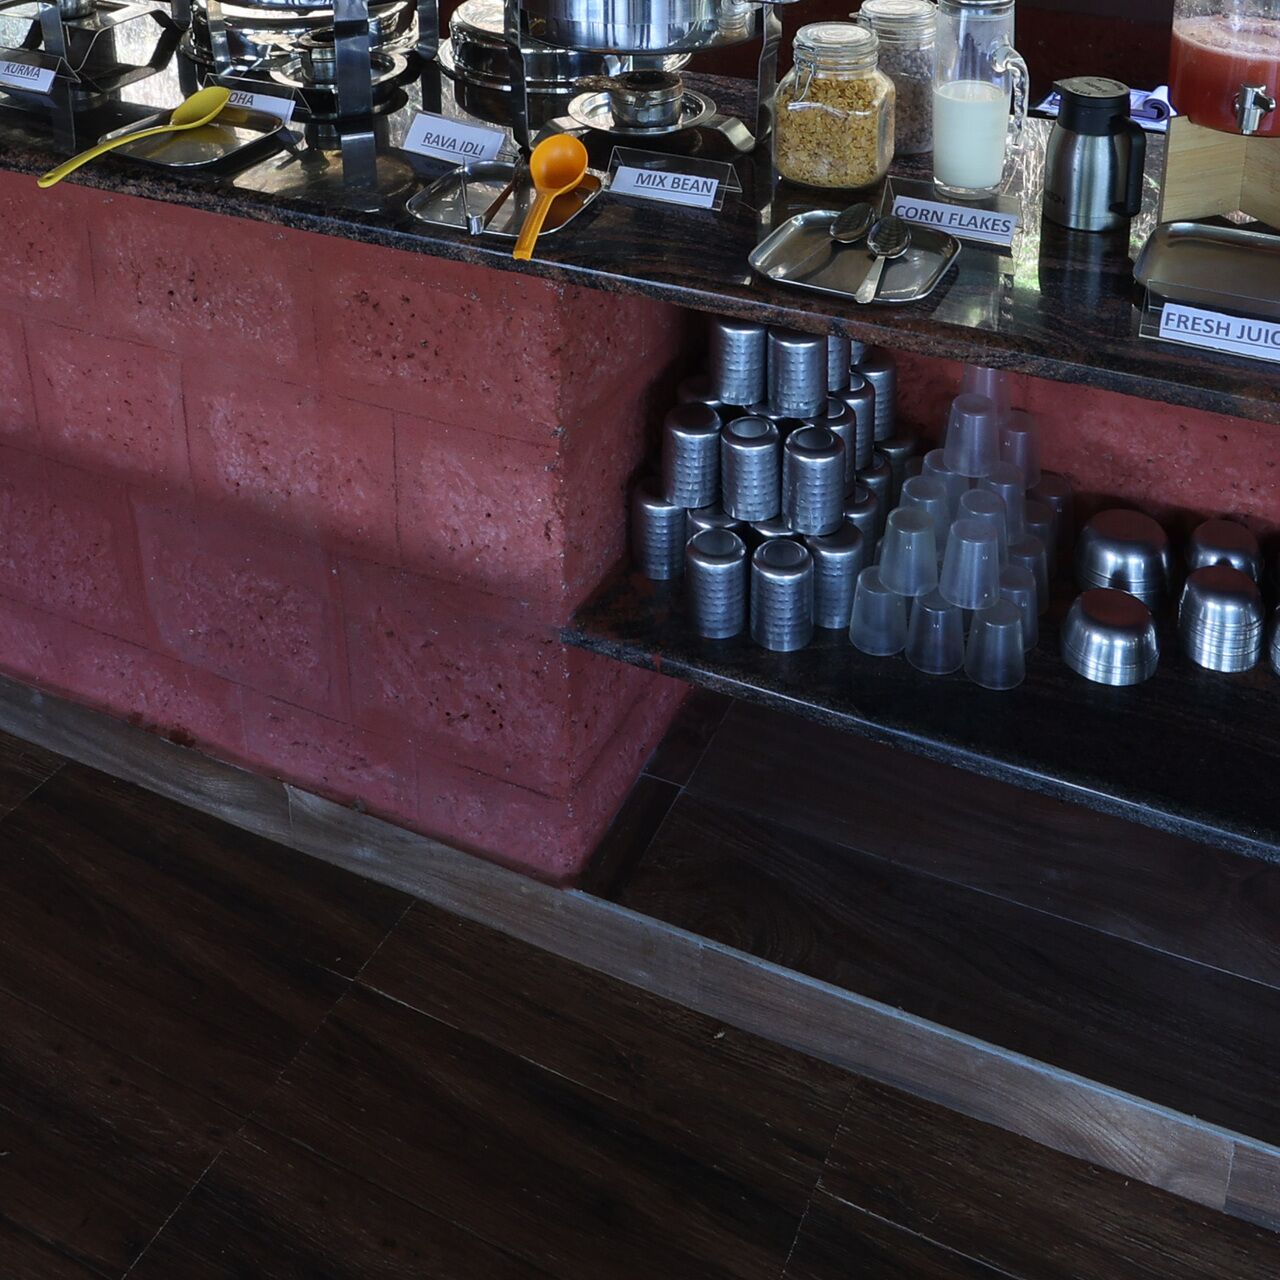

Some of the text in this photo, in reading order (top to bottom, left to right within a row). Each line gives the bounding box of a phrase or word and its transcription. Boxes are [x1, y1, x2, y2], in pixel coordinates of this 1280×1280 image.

[3, 62, 41, 79] KURMA
[228, 92, 254, 106] OHA
[422, 131, 485, 156] RAVA IDLI
[635, 172, 714, 194] MIX BEAN
[894, 204, 1012, 234] CORN FLAKES
[1164, 311, 1231, 338] FRESH
